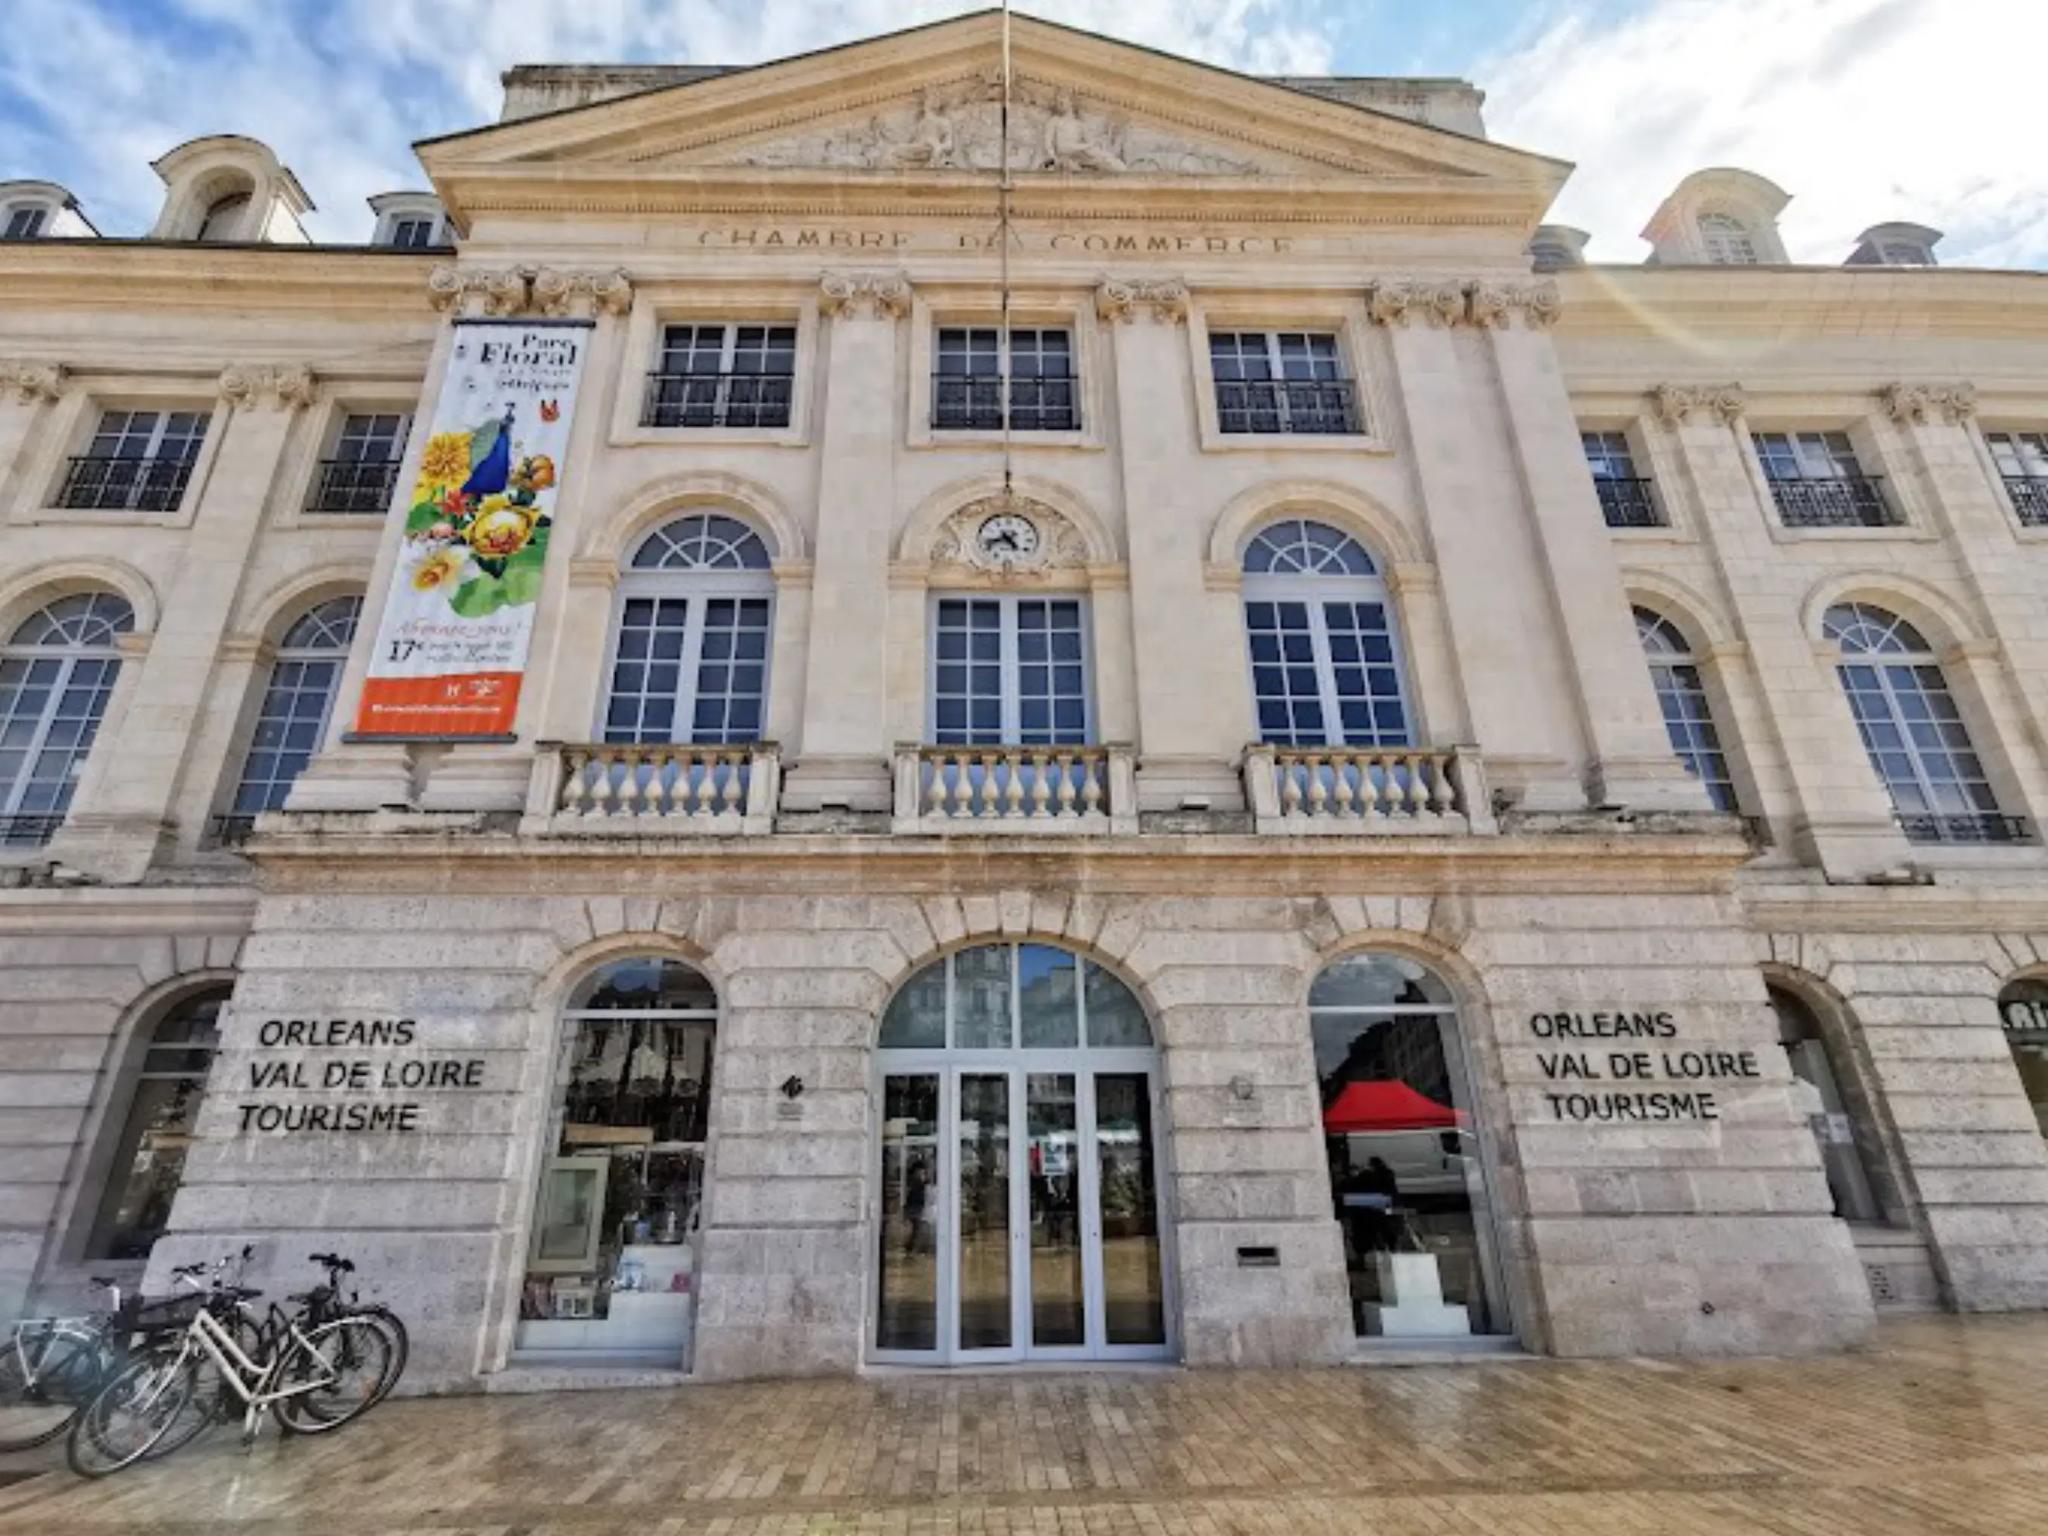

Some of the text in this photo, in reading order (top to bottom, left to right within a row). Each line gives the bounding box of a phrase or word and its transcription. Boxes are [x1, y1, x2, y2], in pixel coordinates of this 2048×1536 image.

[698, 230, 911, 247] CHAMBRE
[1050, 234, 1295, 251] COMMERCE
[480, 342, 576, 366] Floral
[522, 333, 572, 349] Parc
[259, 1019, 416, 1047] ORLEANS
[1530, 1012, 1677, 1038] ORLEANS
[250, 1060, 486, 1089] VAL DE LOIRE
[1536, 1052, 1761, 1079] VAL DE LOIRE
[238, 1104, 419, 1132] TOURISME
[1546, 1093, 1719, 1121] TOURISME
